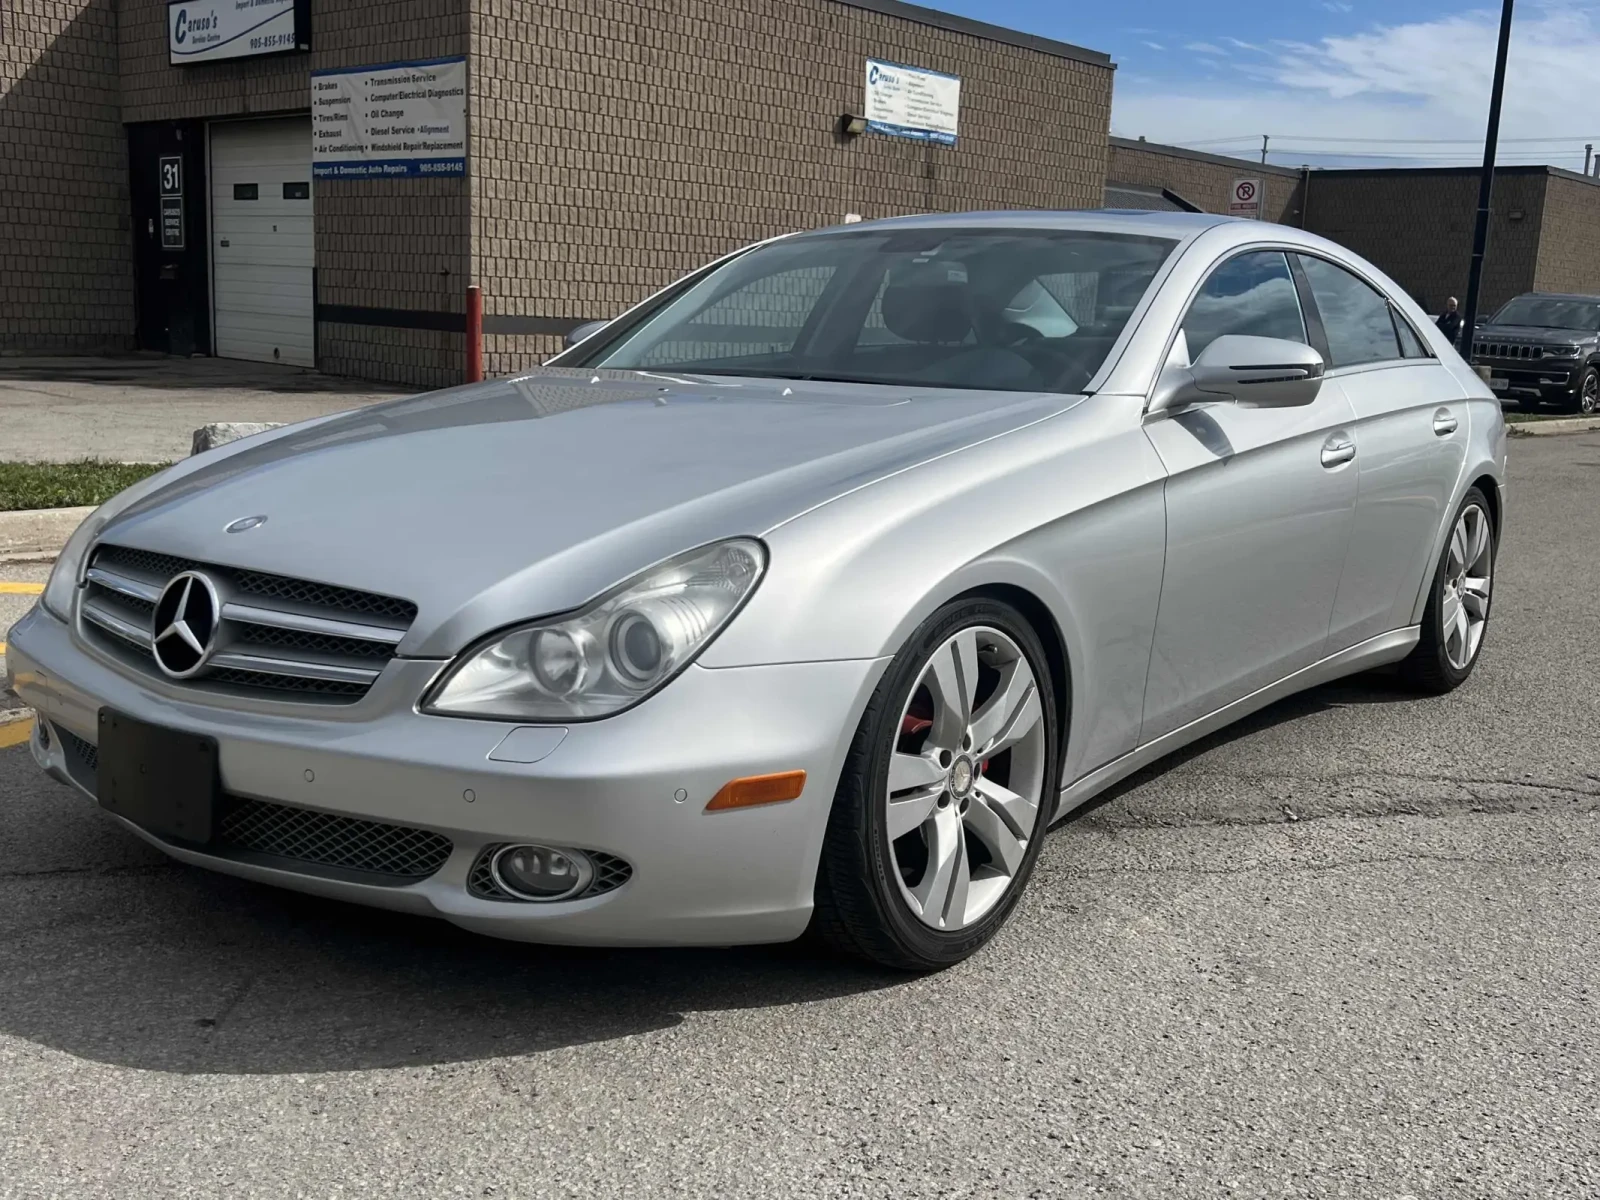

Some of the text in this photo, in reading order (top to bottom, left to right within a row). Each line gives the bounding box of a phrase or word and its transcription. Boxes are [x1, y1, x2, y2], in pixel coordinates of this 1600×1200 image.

[175, 9, 218, 45] Caruso's
[250, 33, 296, 49] 905-855-9145
[370, 73, 437, 87] Transmission Service
[318, 82, 338, 91] Brakes
[427, 87, 464, 100] Diagnostics
[318, 97, 351, 107] Suspension
[370, 109, 405, 119] Oil Change
[318, 129, 342, 139] Exhaust
[370, 127, 390, 136] Diesel
[390, 125, 416, 135] Service
[318, 143, 364, 154] Air Conditioning
[371, 142, 402, 152] Windshield
[368, 165, 383, 174] Auto
[383, 164, 408, 175] Repairs
[164, 164, 179, 189] 31
